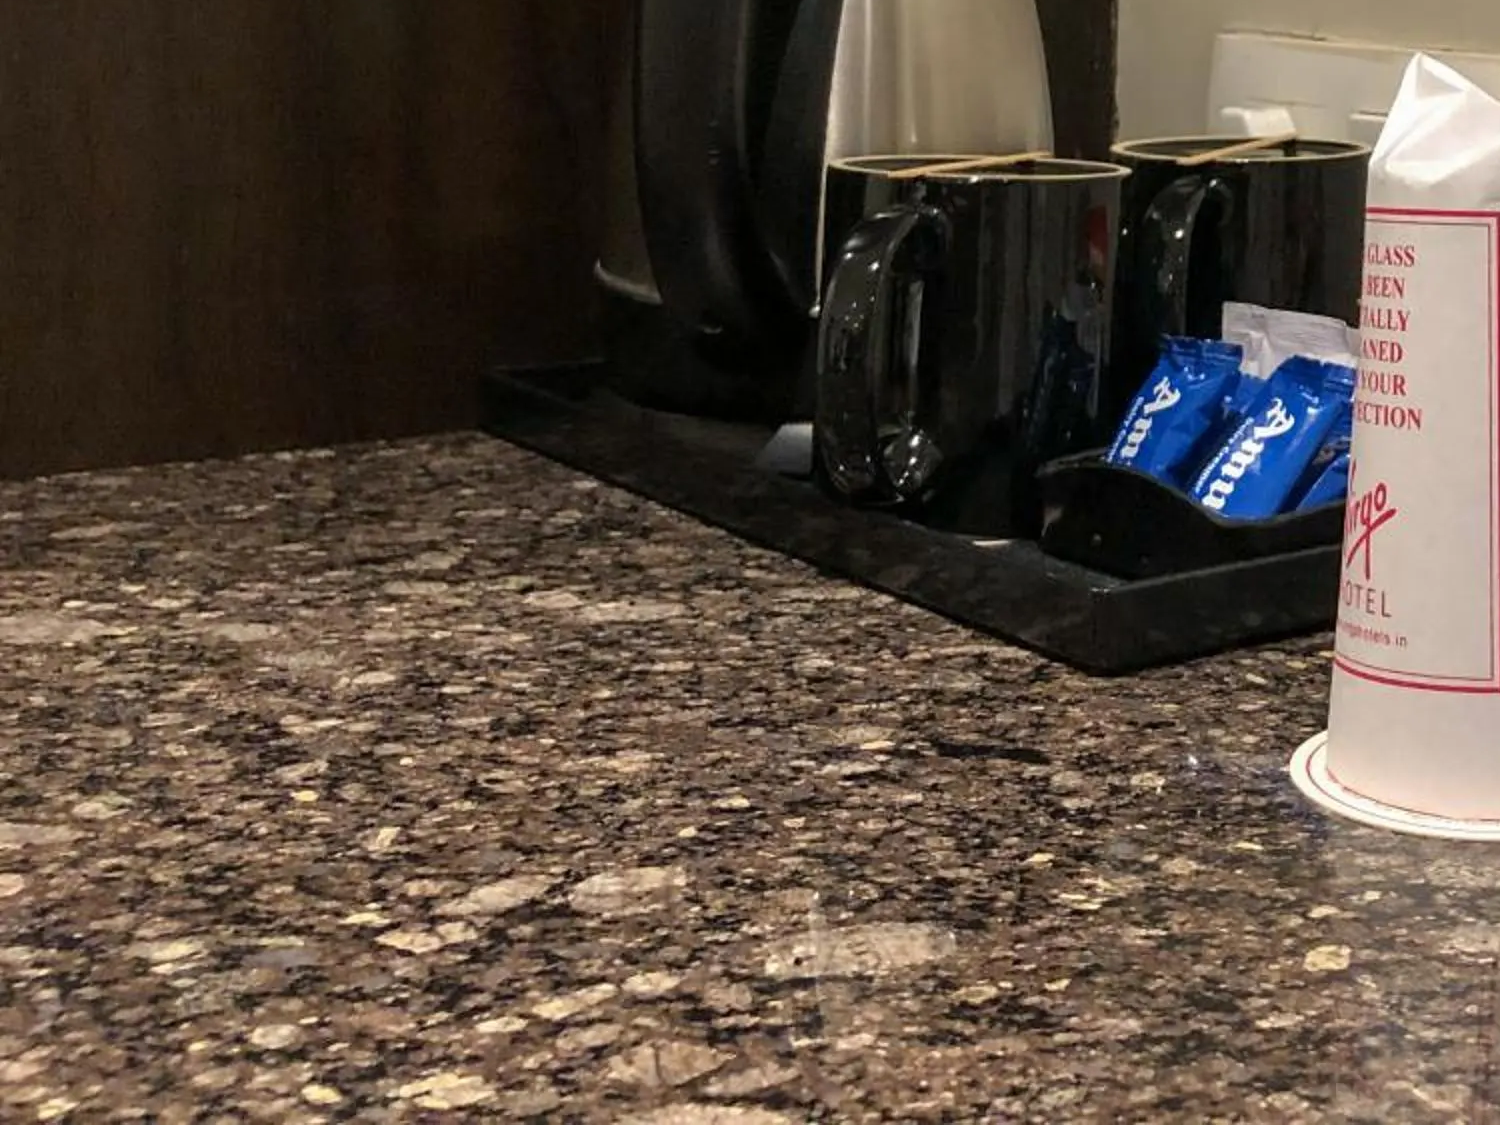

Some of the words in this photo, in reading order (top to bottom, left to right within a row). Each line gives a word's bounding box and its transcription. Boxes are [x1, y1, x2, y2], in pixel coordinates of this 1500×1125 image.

[1367, 243, 1415, 267] GLASS
[1367, 275, 1405, 299] BEEN
[1360, 370, 1406, 396] YOUR
[1356, 400, 1422, 430] ECTION
[1345, 579, 1392, 618] OTEL
